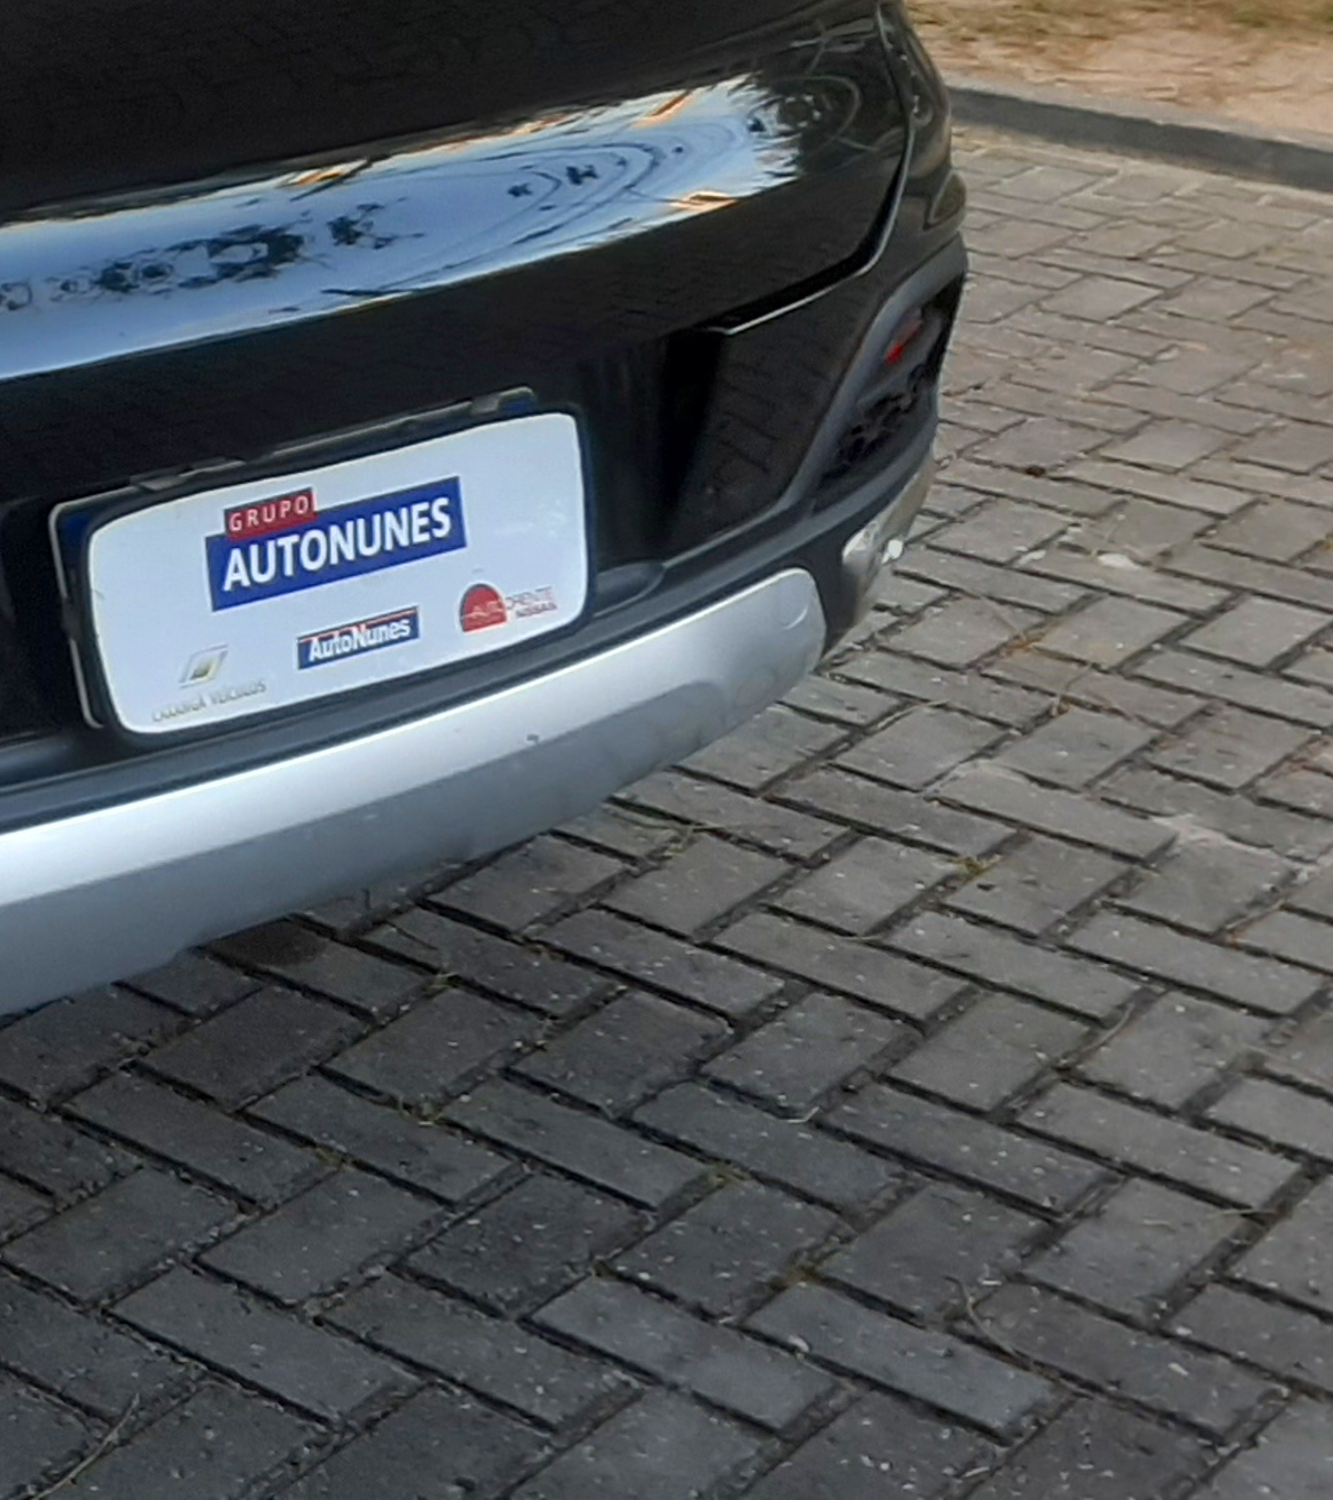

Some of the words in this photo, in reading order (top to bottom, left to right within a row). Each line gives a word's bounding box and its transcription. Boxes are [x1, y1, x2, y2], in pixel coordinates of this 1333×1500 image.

[228, 494, 310, 532] GRUPO
[222, 496, 452, 592] AUTONUNES
[308, 618, 411, 662] AutoNunes
